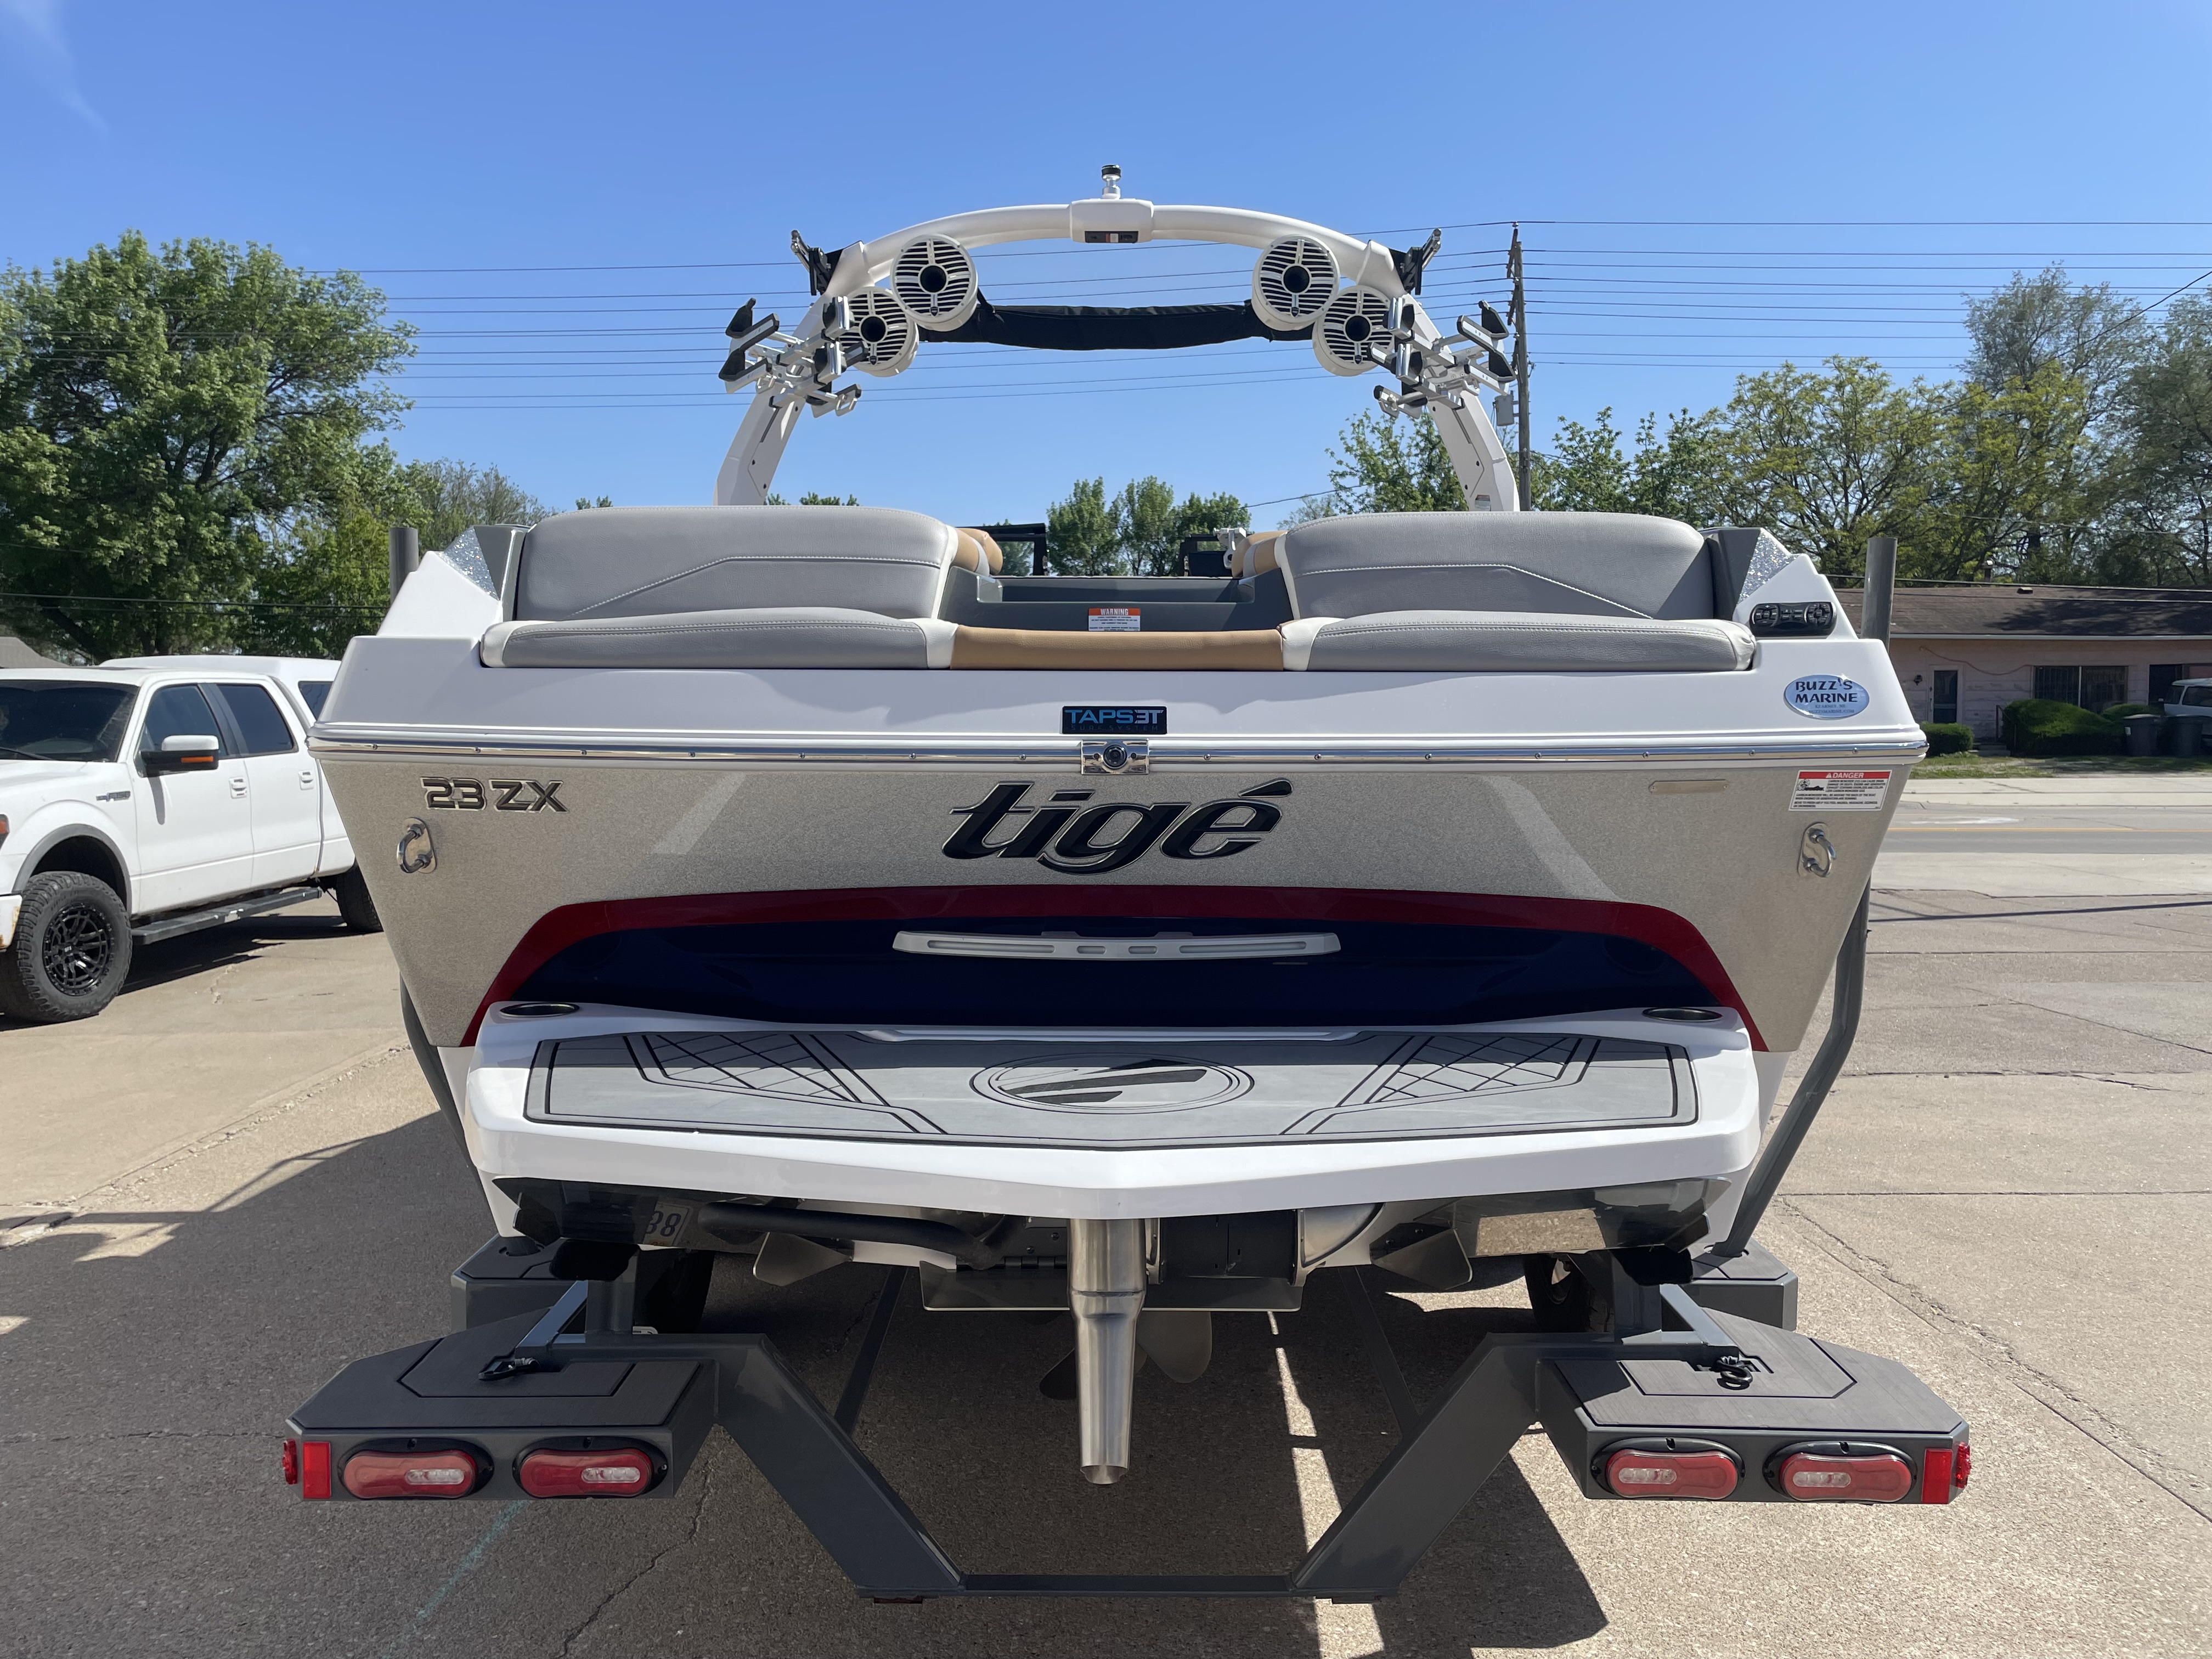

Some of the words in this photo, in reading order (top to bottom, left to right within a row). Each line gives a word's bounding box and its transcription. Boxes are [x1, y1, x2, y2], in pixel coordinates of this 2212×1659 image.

[1795, 677, 1853, 692] BUZZ'S
[1795, 692, 1858, 703] MARINE
[420, 776, 487, 811] 23
[488, 778, 569, 813] ZX
[941, 777, 1293, 874] tigé
